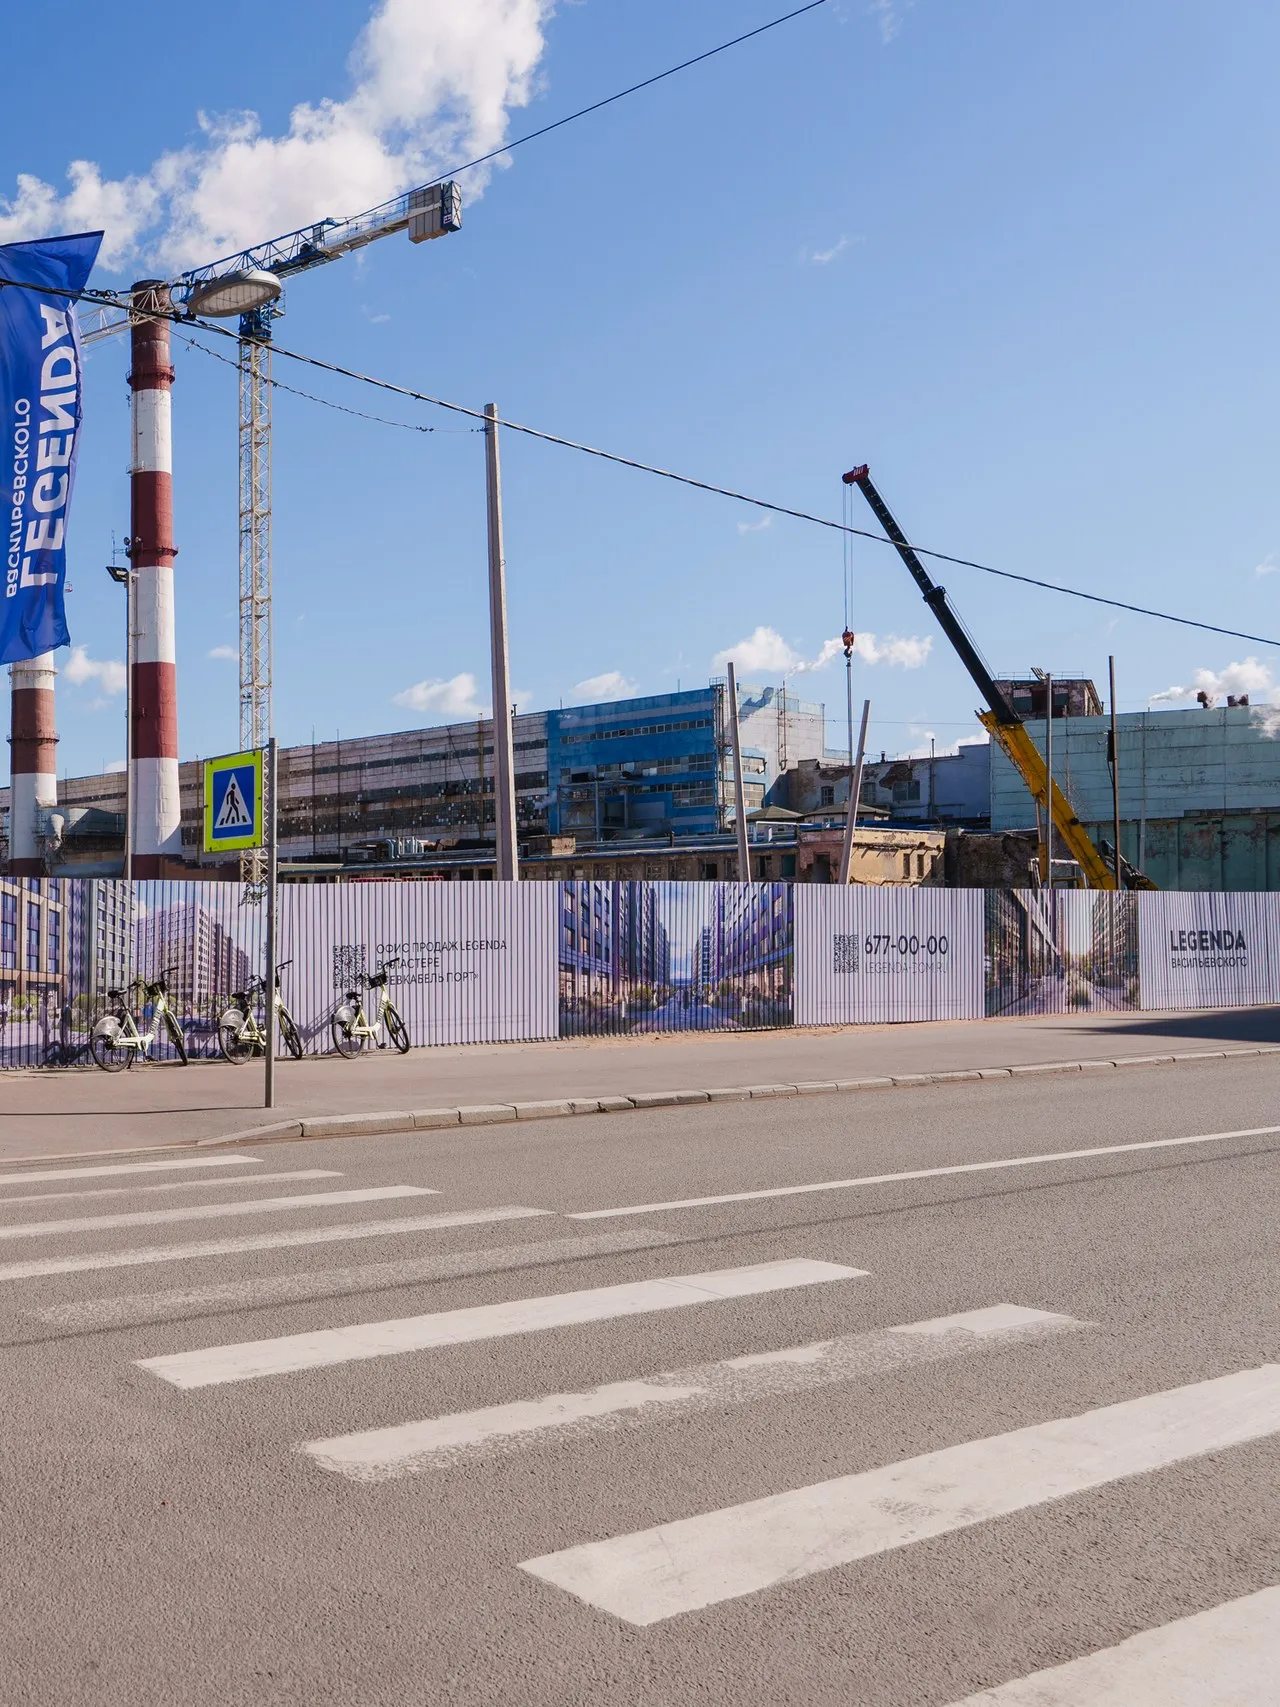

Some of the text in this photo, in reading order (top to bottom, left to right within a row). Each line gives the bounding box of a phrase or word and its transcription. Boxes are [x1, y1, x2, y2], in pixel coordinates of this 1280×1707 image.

[376, 940, 507, 955] ОФИС ПРОДАЖ LEGENDA
[865, 935, 949, 955] 677-00-00
[1170, 930, 1246, 952] LEGENDA
[1171, 957, 1248, 969] ВАСИЛЬЕВСКОГО
